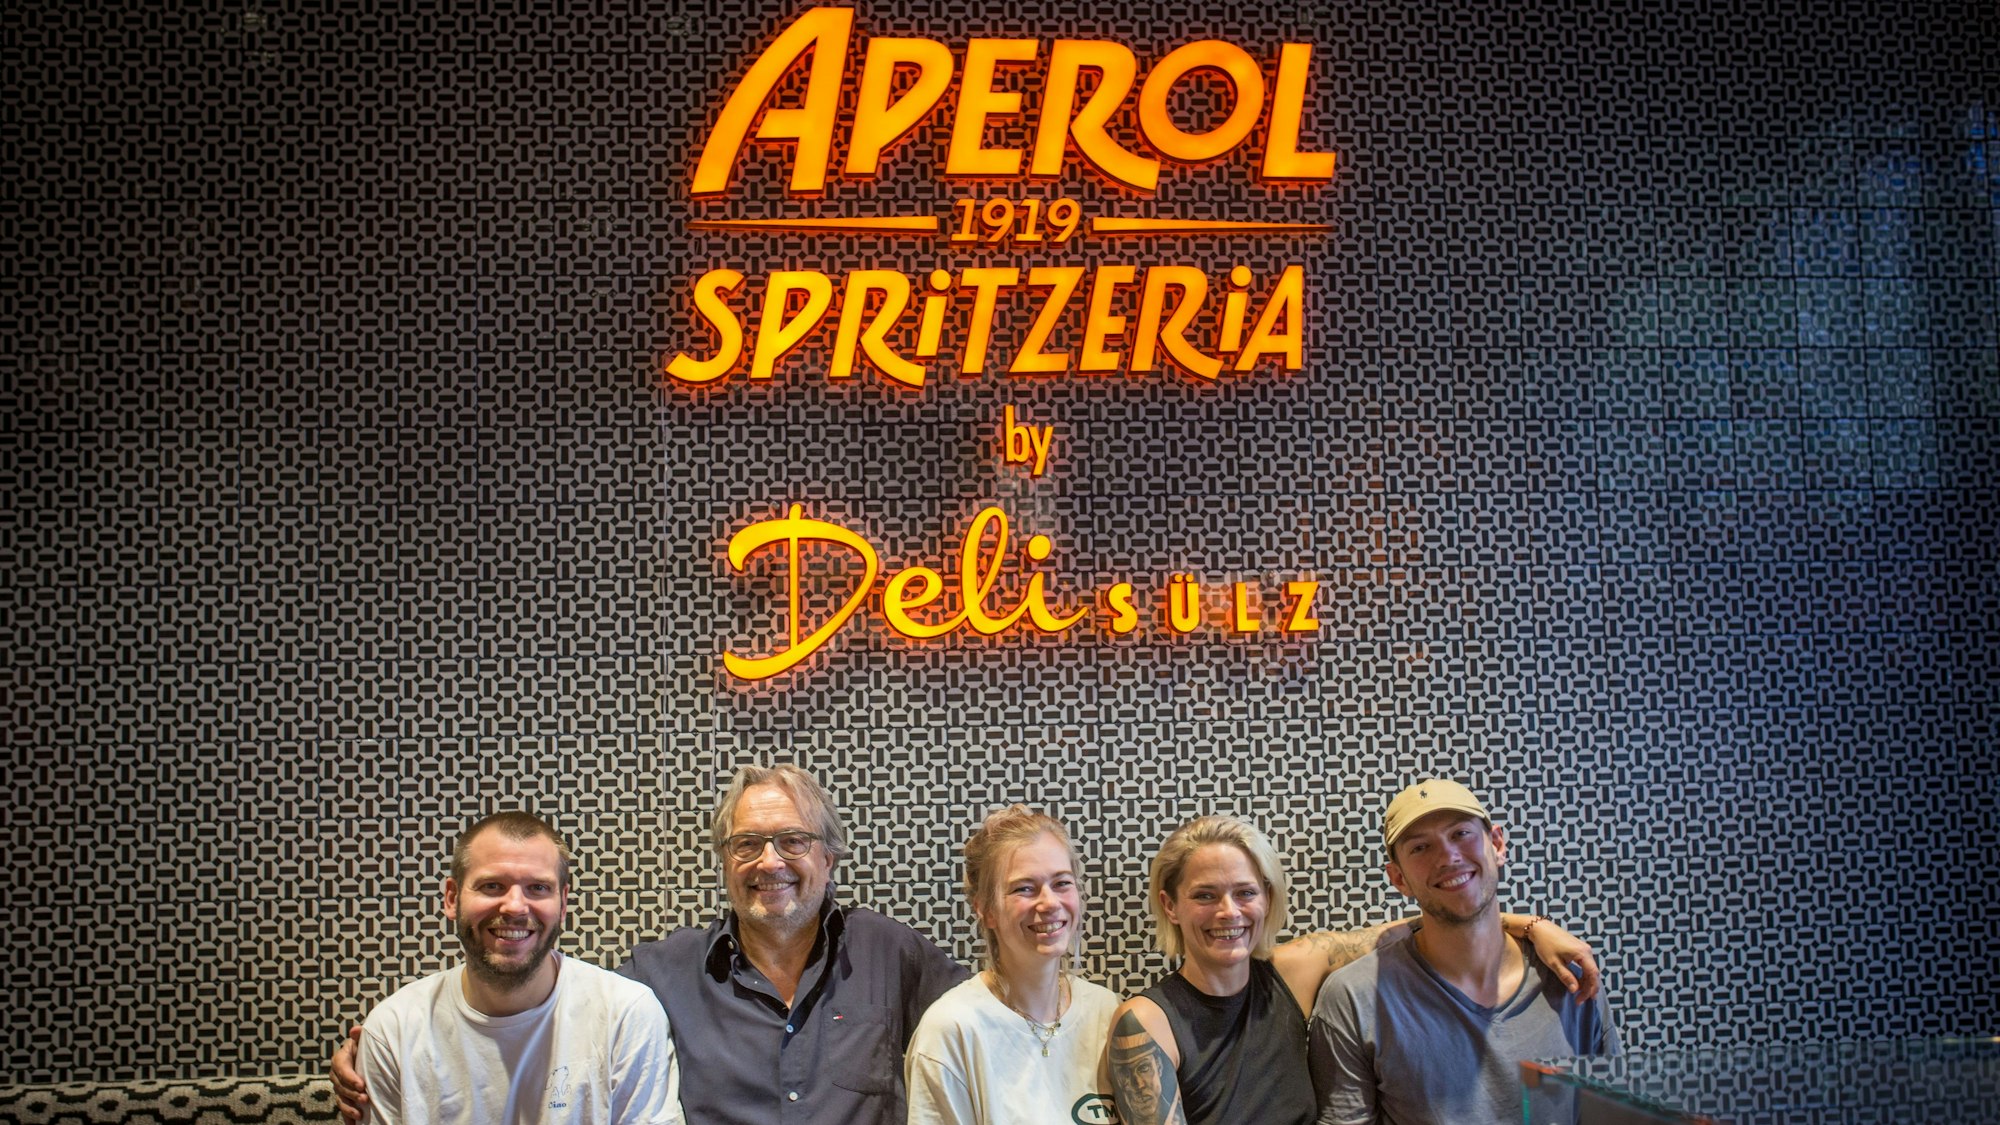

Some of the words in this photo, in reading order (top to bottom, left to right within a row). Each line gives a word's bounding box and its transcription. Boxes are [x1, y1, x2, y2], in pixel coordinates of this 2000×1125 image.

[690, 6, 1336, 197] APEROL
[950, 198, 1081, 246] 1919
[1003, 404, 1054, 478] by
[723, 503, 1088, 681] Deli
[1087, 1104, 1118, 1119] TM
